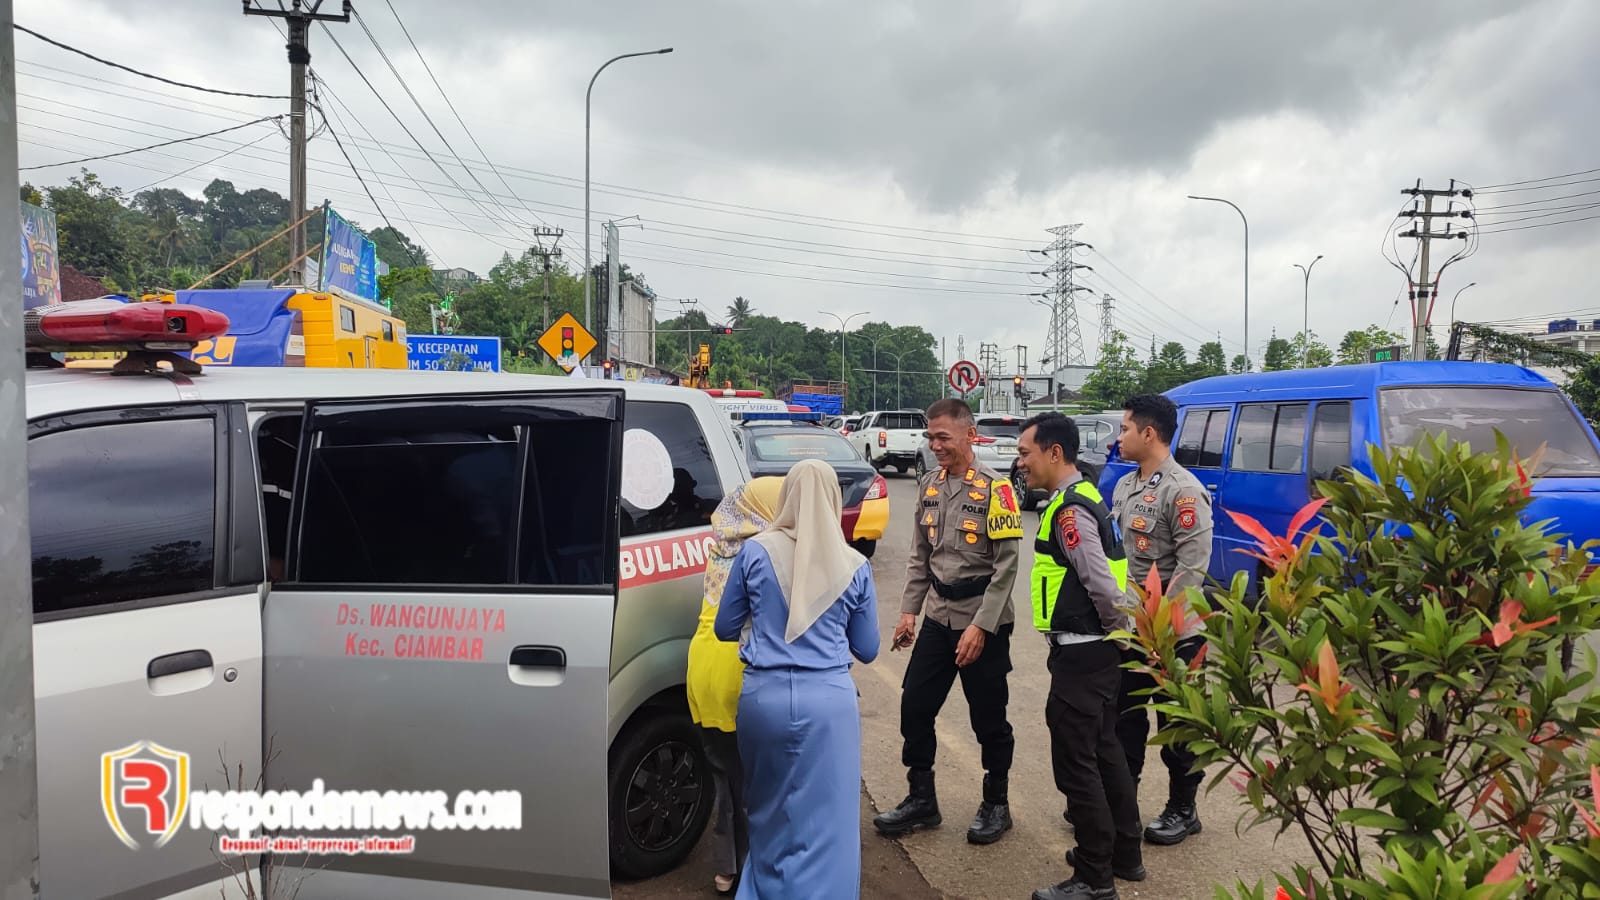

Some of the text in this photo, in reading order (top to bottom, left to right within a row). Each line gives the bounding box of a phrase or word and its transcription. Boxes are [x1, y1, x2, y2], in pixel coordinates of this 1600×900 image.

[418, 343, 478, 355] KECEPATAN
[961, 504, 987, 516] POLRI
[1134, 503, 1156, 517] POLRI
[336, 603, 506, 632] Ds. WANGUNJAYA
[344, 632, 484, 661] Kec. CIAMBAR
